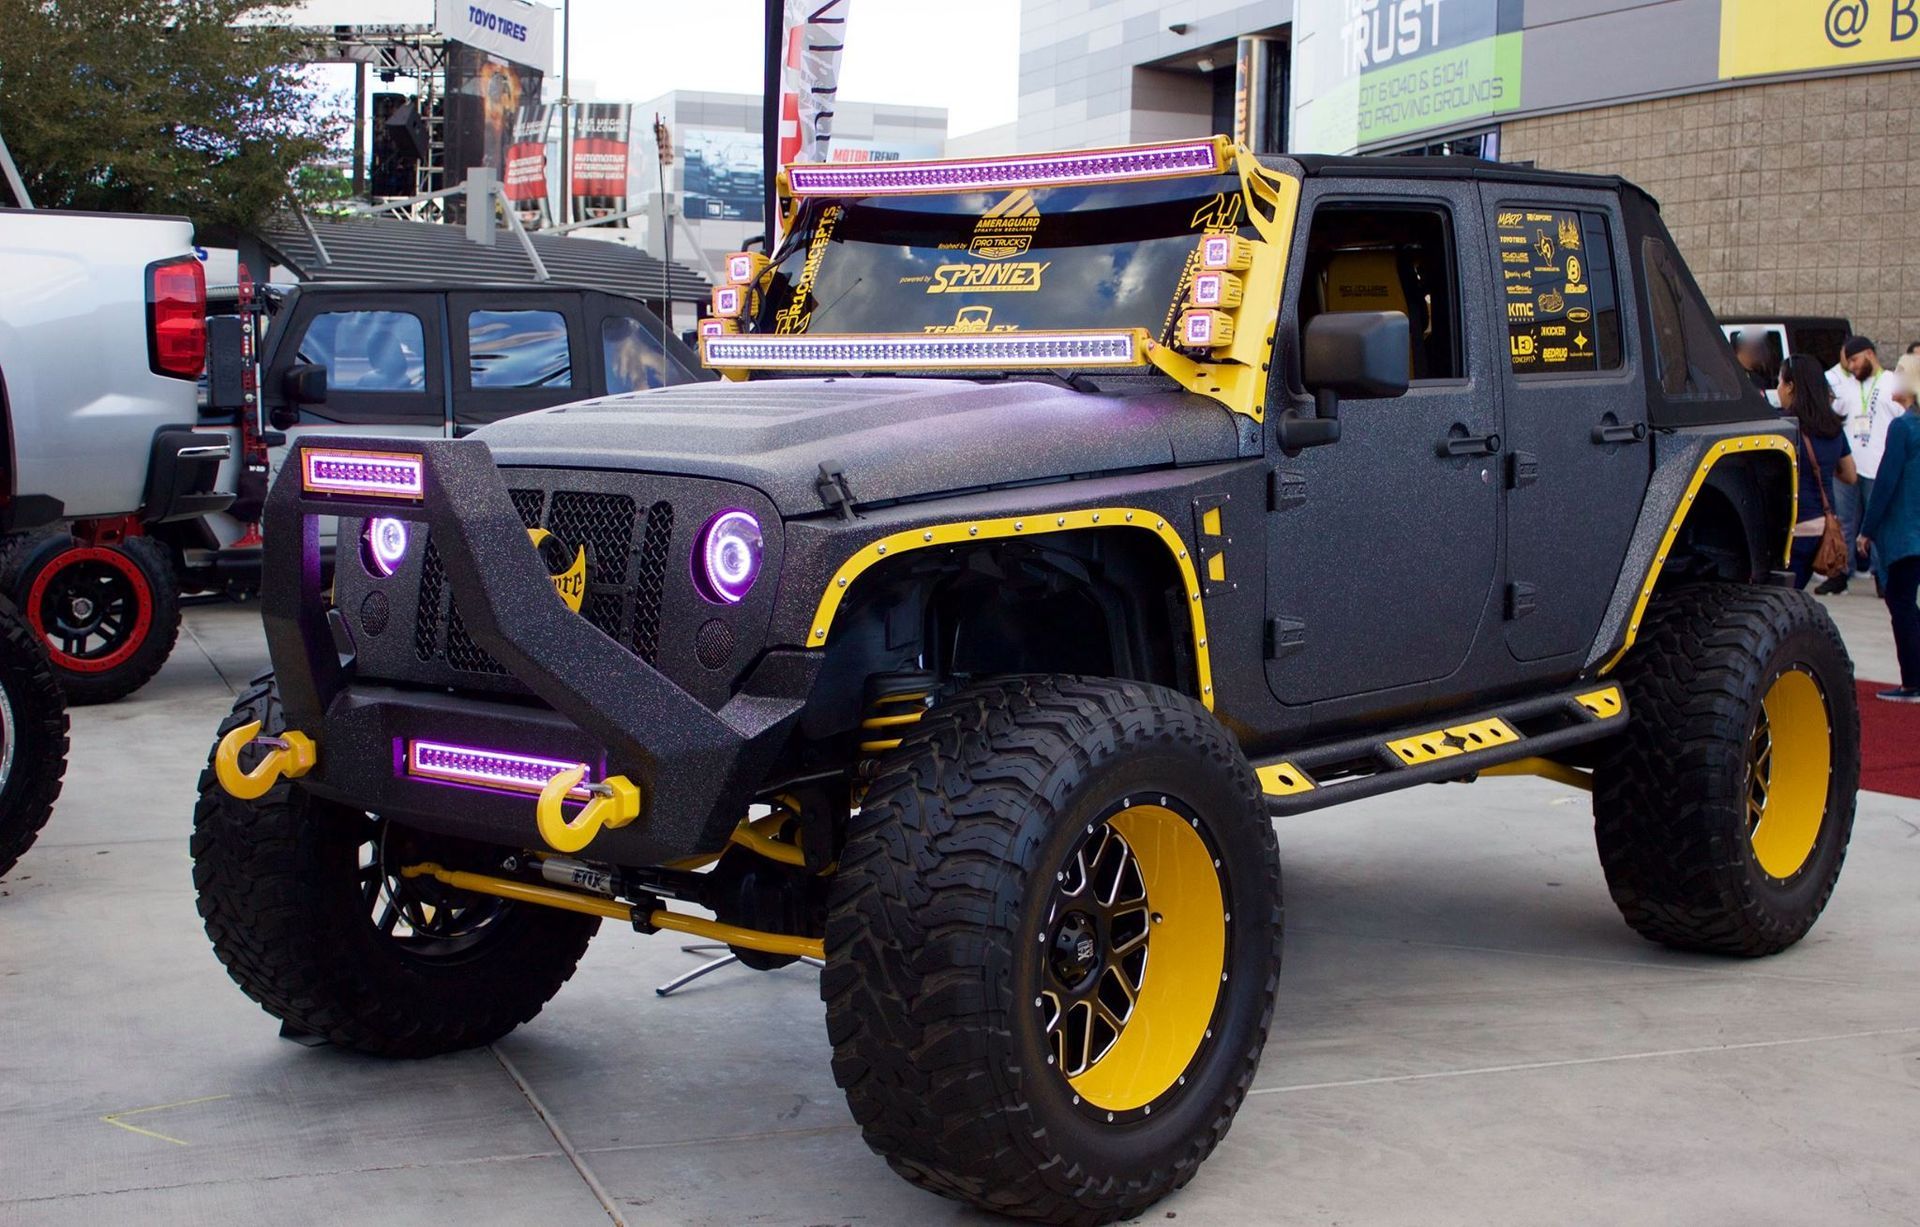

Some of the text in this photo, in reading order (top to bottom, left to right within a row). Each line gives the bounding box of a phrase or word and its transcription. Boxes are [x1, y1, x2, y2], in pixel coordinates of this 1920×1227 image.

[469, 6, 527, 42] TOYO TIRES
[1825, 0, 1868, 48] @
[1341, 0, 1446, 77] TRUST
[1379, 73, 1416, 101] 61040
[1433, 59, 1469, 88] 61041
[1375, 95, 1431, 128] PROVING
[1434, 77, 1503, 114] GROUNDS
[976, 217, 1040, 228] AMERAGUARD
[959, 242, 968, 250] by
[974, 238, 1027, 249] PRO TRUCKS
[900, 276, 931, 284] powered by
[926, 262, 1051, 294] SPRINTEX
[1508, 303, 1534, 316] KMC
[1510, 336, 1534, 355] LED
